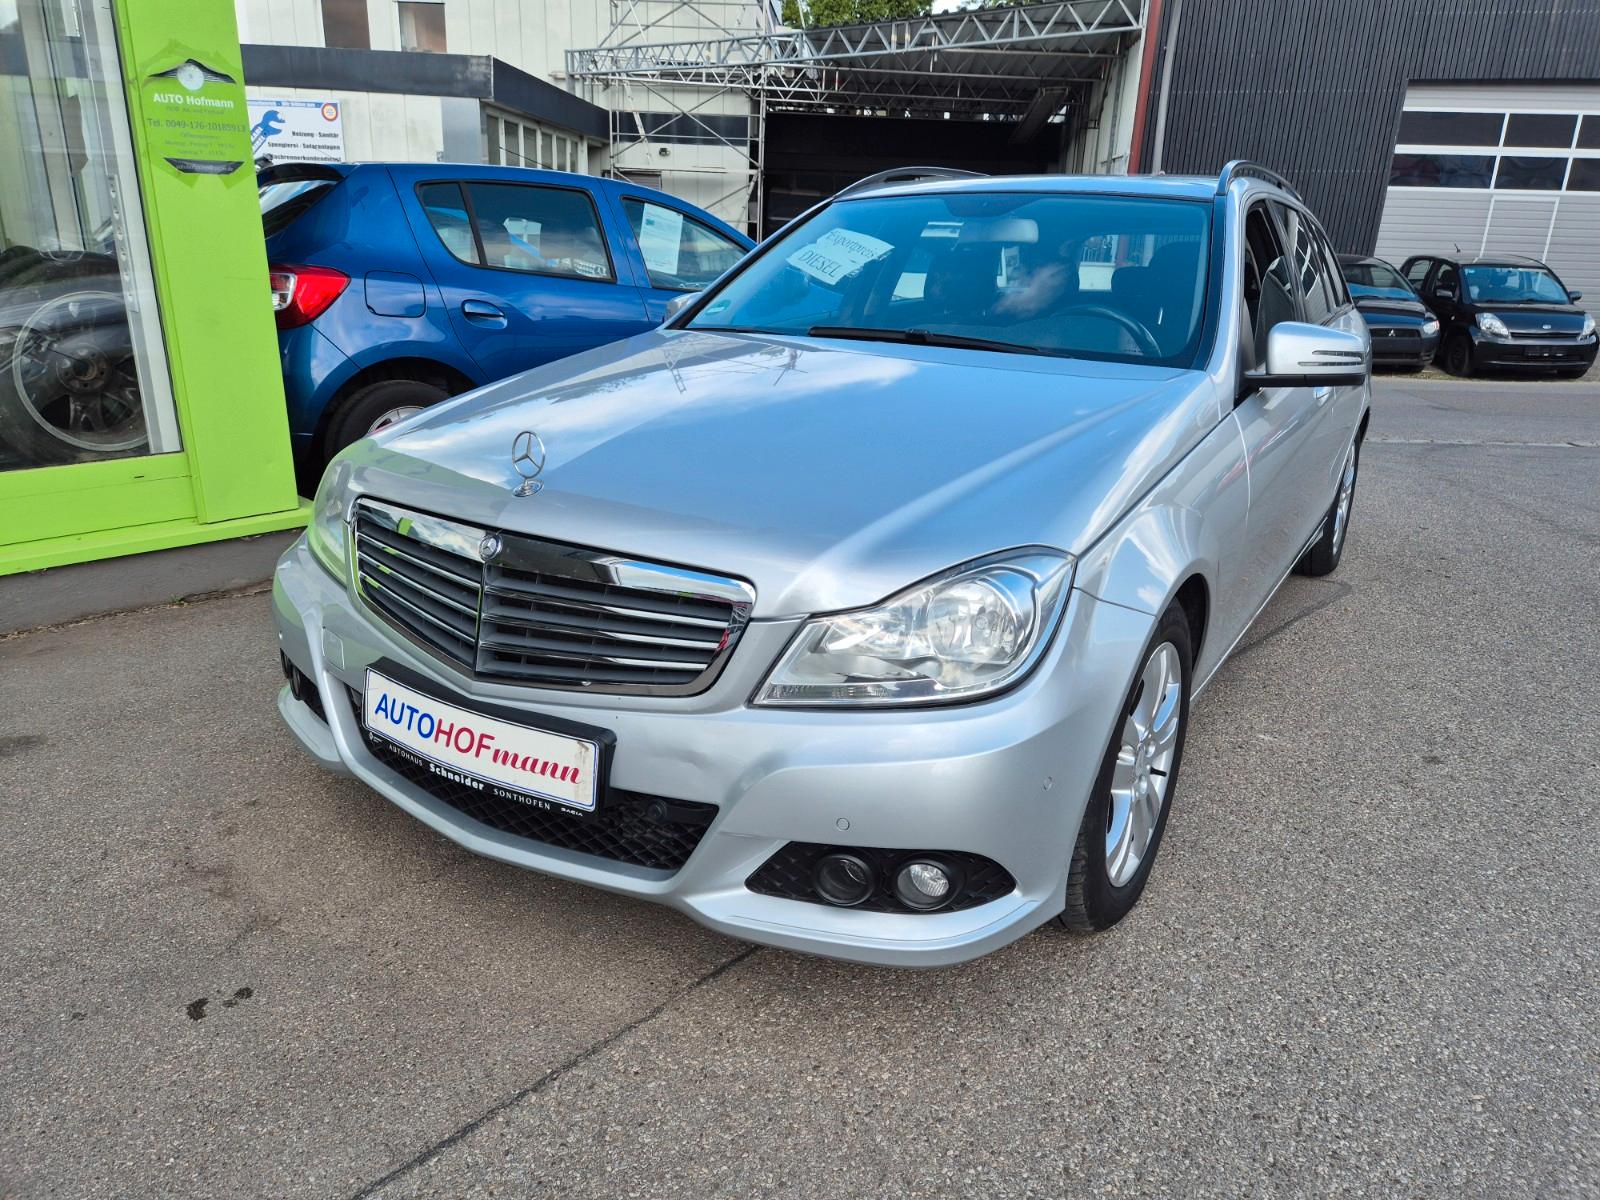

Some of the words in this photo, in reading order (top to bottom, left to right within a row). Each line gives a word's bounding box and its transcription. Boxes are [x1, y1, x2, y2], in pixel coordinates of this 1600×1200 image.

[153, 92, 183, 104] AUTO
[186, 95, 235, 109] Hofmann
[291, 130, 315, 138] Heizung
[798, 250, 843, 278] DIESEL
[388, 743, 423, 767] AUTOHAUS
[429, 763, 485, 791] Schneider
[493, 788, 551, 811] SONTHOFEN
